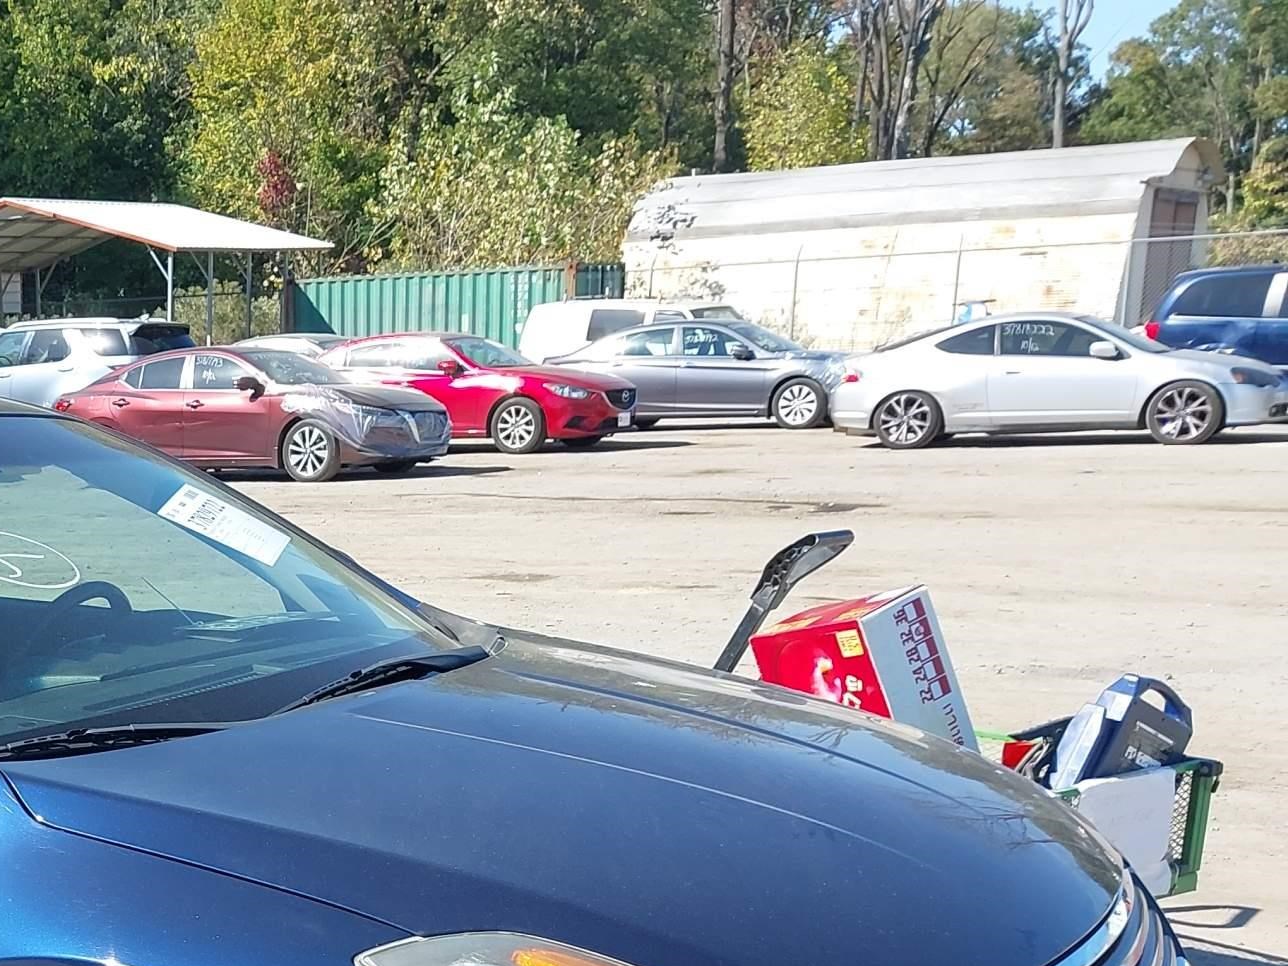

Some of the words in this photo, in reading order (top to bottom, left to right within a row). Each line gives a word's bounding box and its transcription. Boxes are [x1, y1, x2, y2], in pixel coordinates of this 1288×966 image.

[893, 609, 907, 626] 36
[900, 628, 915, 646] 32
[906, 646, 921, 665] 28
[913, 666, 928, 684] 24
[920, 684, 934, 704] 22
